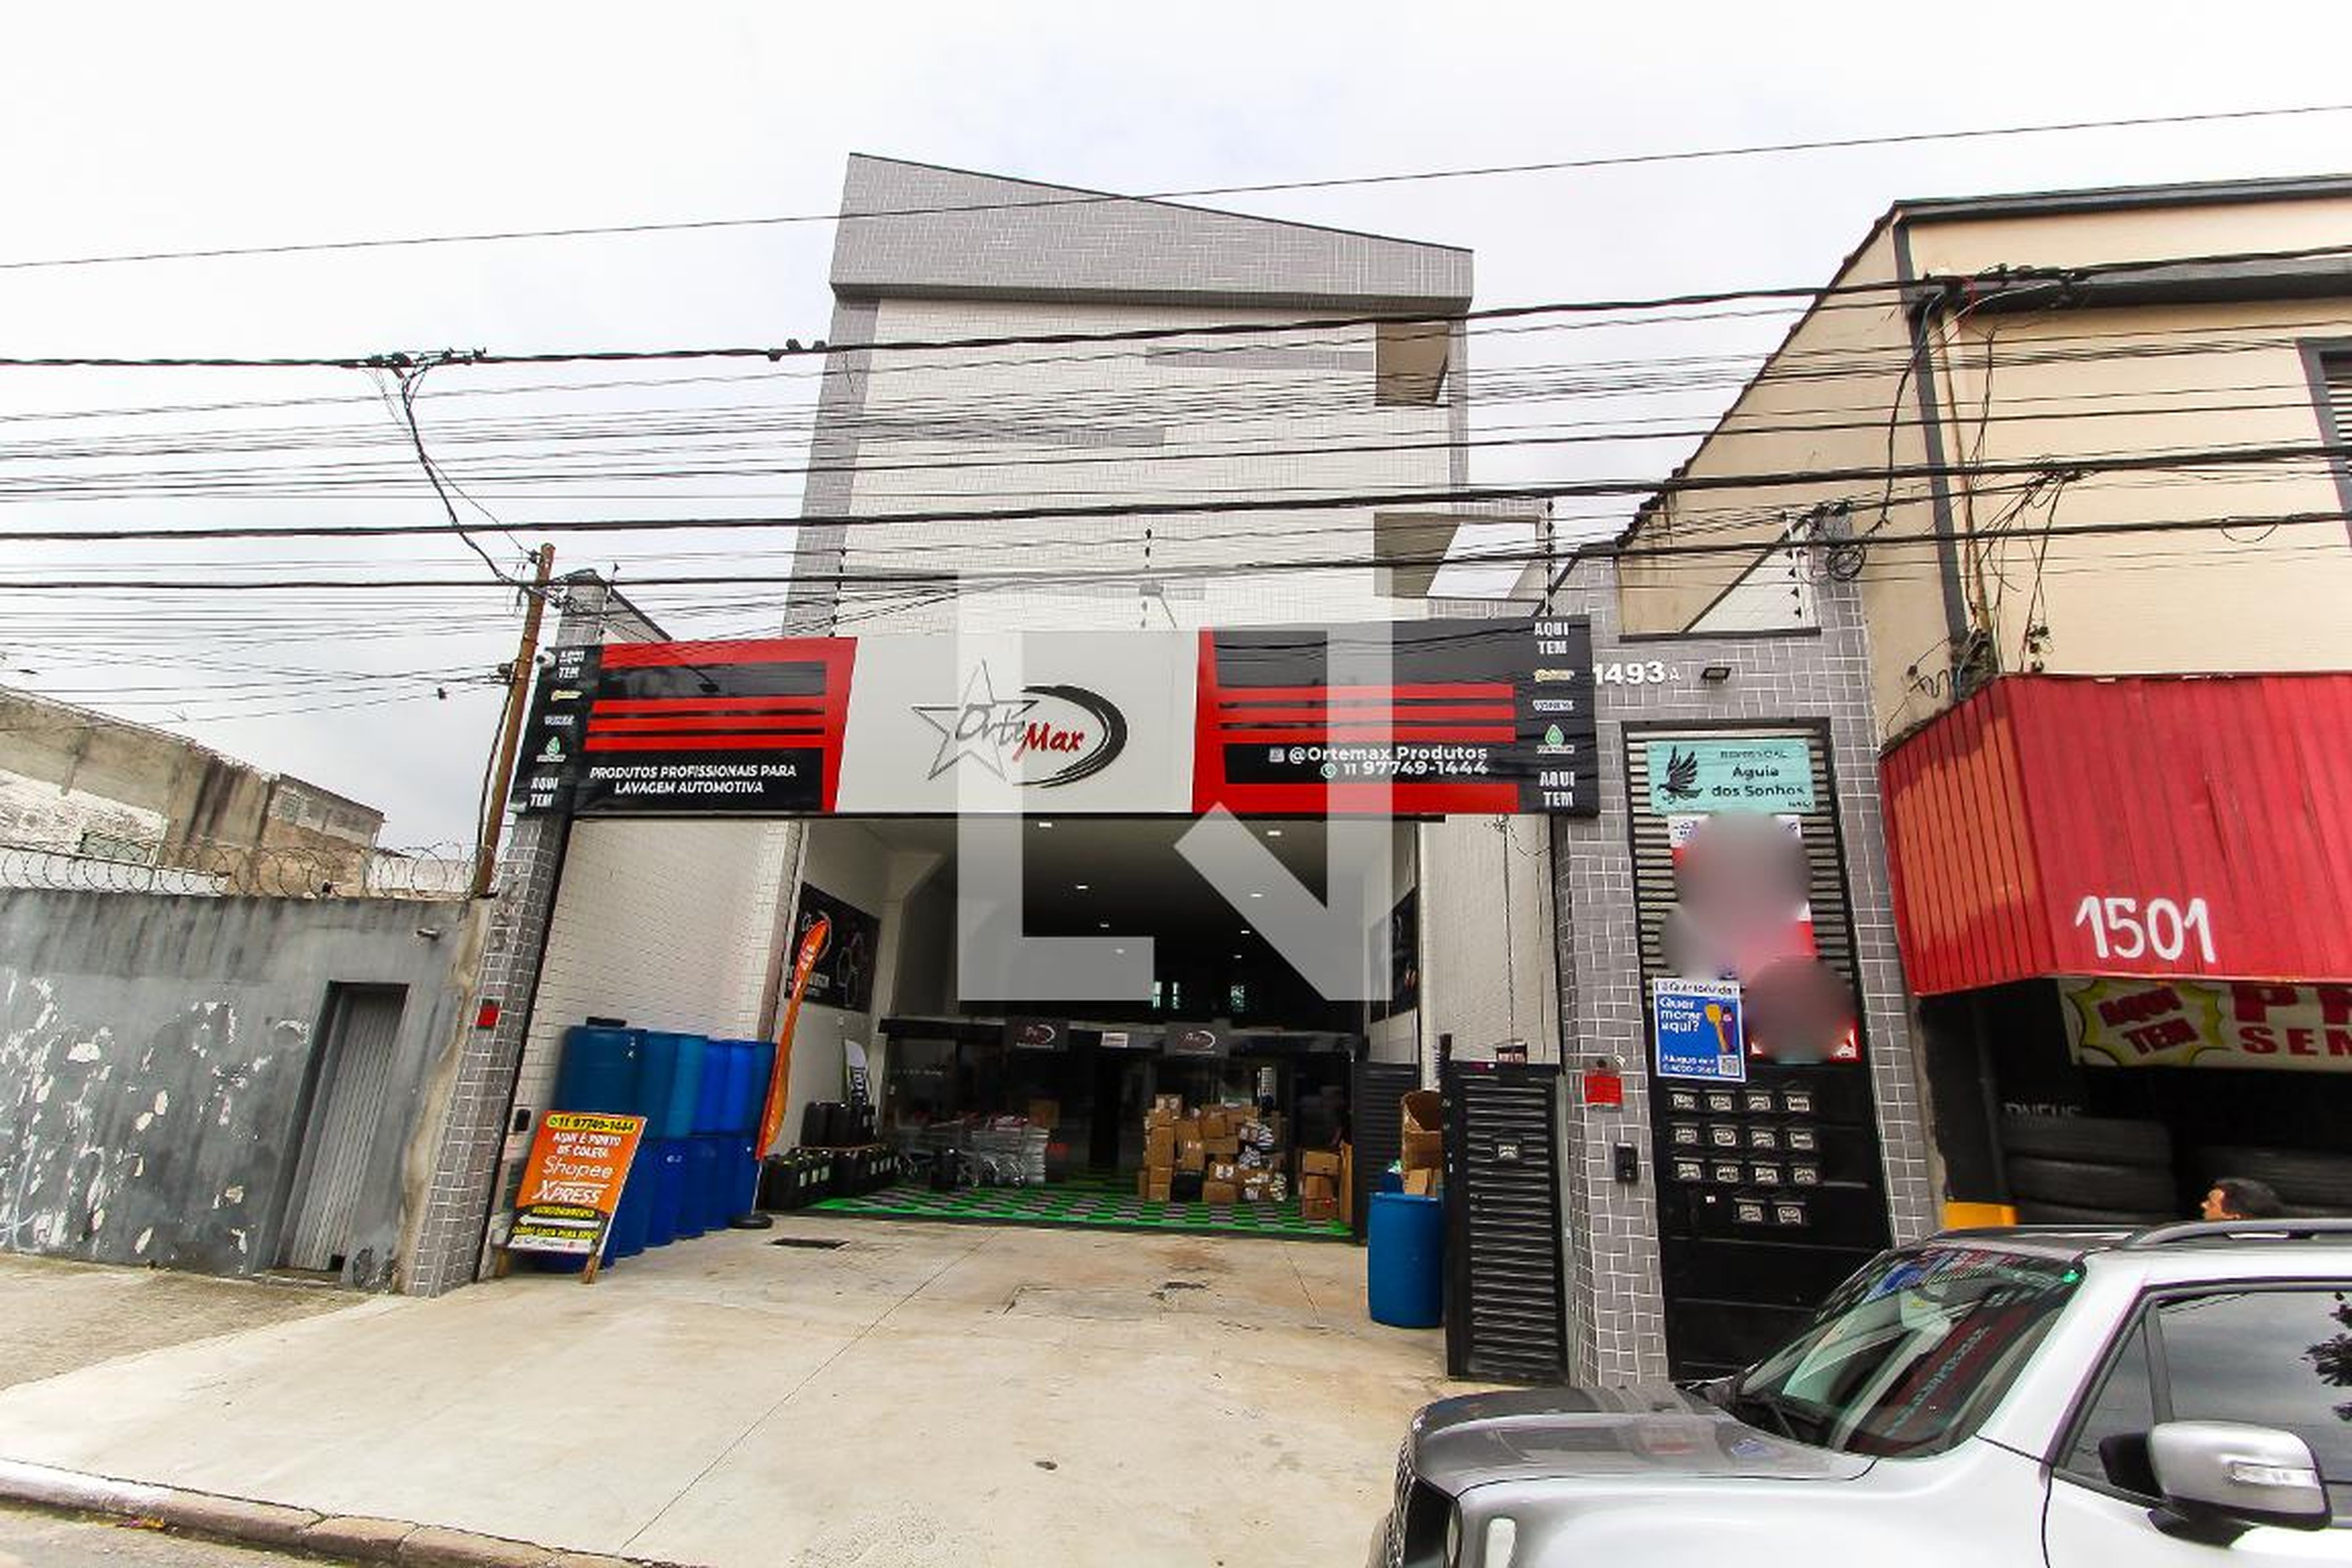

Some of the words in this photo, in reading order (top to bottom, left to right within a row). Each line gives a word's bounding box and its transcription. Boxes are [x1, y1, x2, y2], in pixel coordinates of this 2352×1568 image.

[1534, 622, 1569, 635] AQUI
[1537, 641, 1567, 654] TEM
[1593, 662, 1665, 685] 1493
[590, 767, 658, 779] PRODUTOS
[660, 765, 758, 778] PROFISSIONAIS
[761, 764, 797, 777] PARA
[1344, 763, 1357, 774] 11
[1363, 760, 1489, 775] 97749-1444
[1539, 772, 1575, 786] AQUI
[614, 781, 676, 794] LAVAGEM
[678, 780, 764, 793] AUTOMOTIVA
[1712, 785, 1740, 796] dos
[1745, 785, 1805, 796] Sonhos
[530, 794, 554, 807] TEM
[1543, 791, 1574, 807] TEM
[2076, 895, 2216, 963] 1501
[1659, 997, 1694, 1009] Quer
[543, 1156, 614, 1180] Shopee
[532, 1180, 609, 1204] XPRESS
